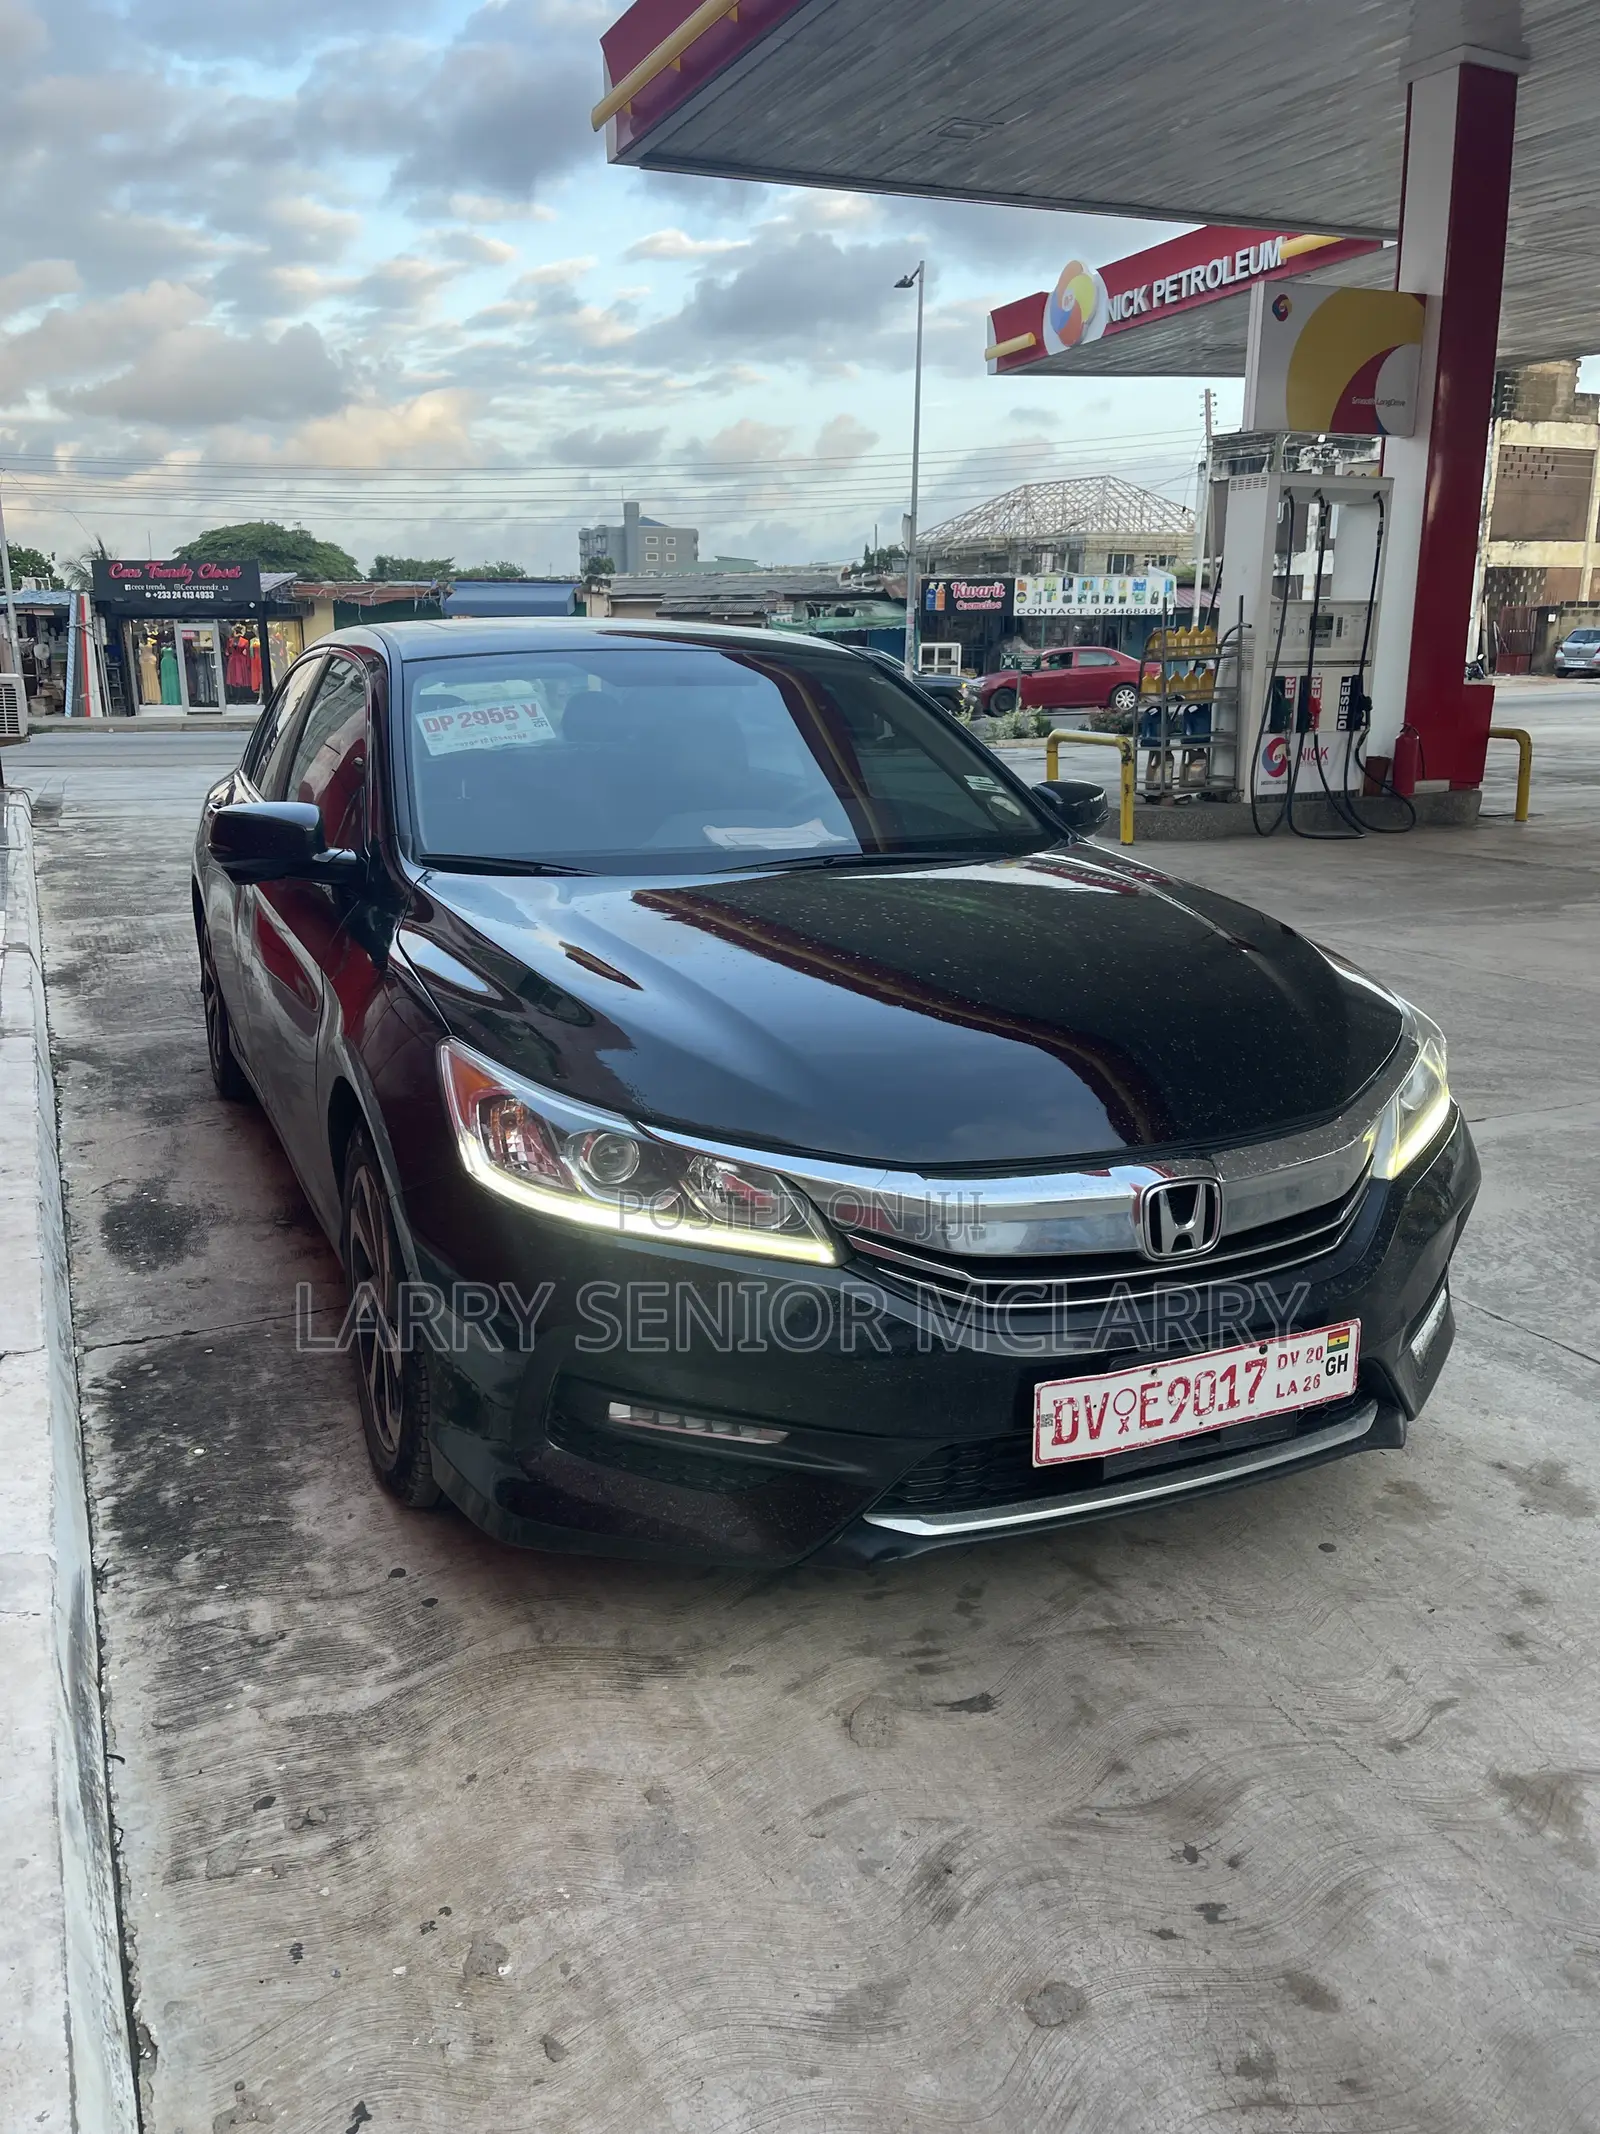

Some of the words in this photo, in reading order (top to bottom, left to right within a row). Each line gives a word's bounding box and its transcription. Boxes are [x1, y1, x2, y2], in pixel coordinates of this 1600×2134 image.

[1106, 285, 1151, 323] NICK
[1152, 235, 1288, 309] PETROLEUM
[109, 562, 143, 579] Cece
[198, 562, 242, 580] Closet
[145, 583, 166, 591] trends
[950, 582, 1006, 599] Kwarit
[1016, 607, 1090, 615] CONTACT:
[1337, 677, 1352, 730] DIESEL
[422, 715, 454, 733] DP
[457, 705, 520, 729] 2955
[520, 703, 539, 718] V
[1278, 1352, 1300, 1370] DV
[1306, 1345, 1324, 1364] 20
[1325, 1353, 1349, 1377] GH
[1276, 1379, 1299, 1399] LA
[1303, 1373, 1321, 1393] 26
[1051, 1391, 1111, 1446] DV
[1139, 1356, 1269, 1429] E9017
